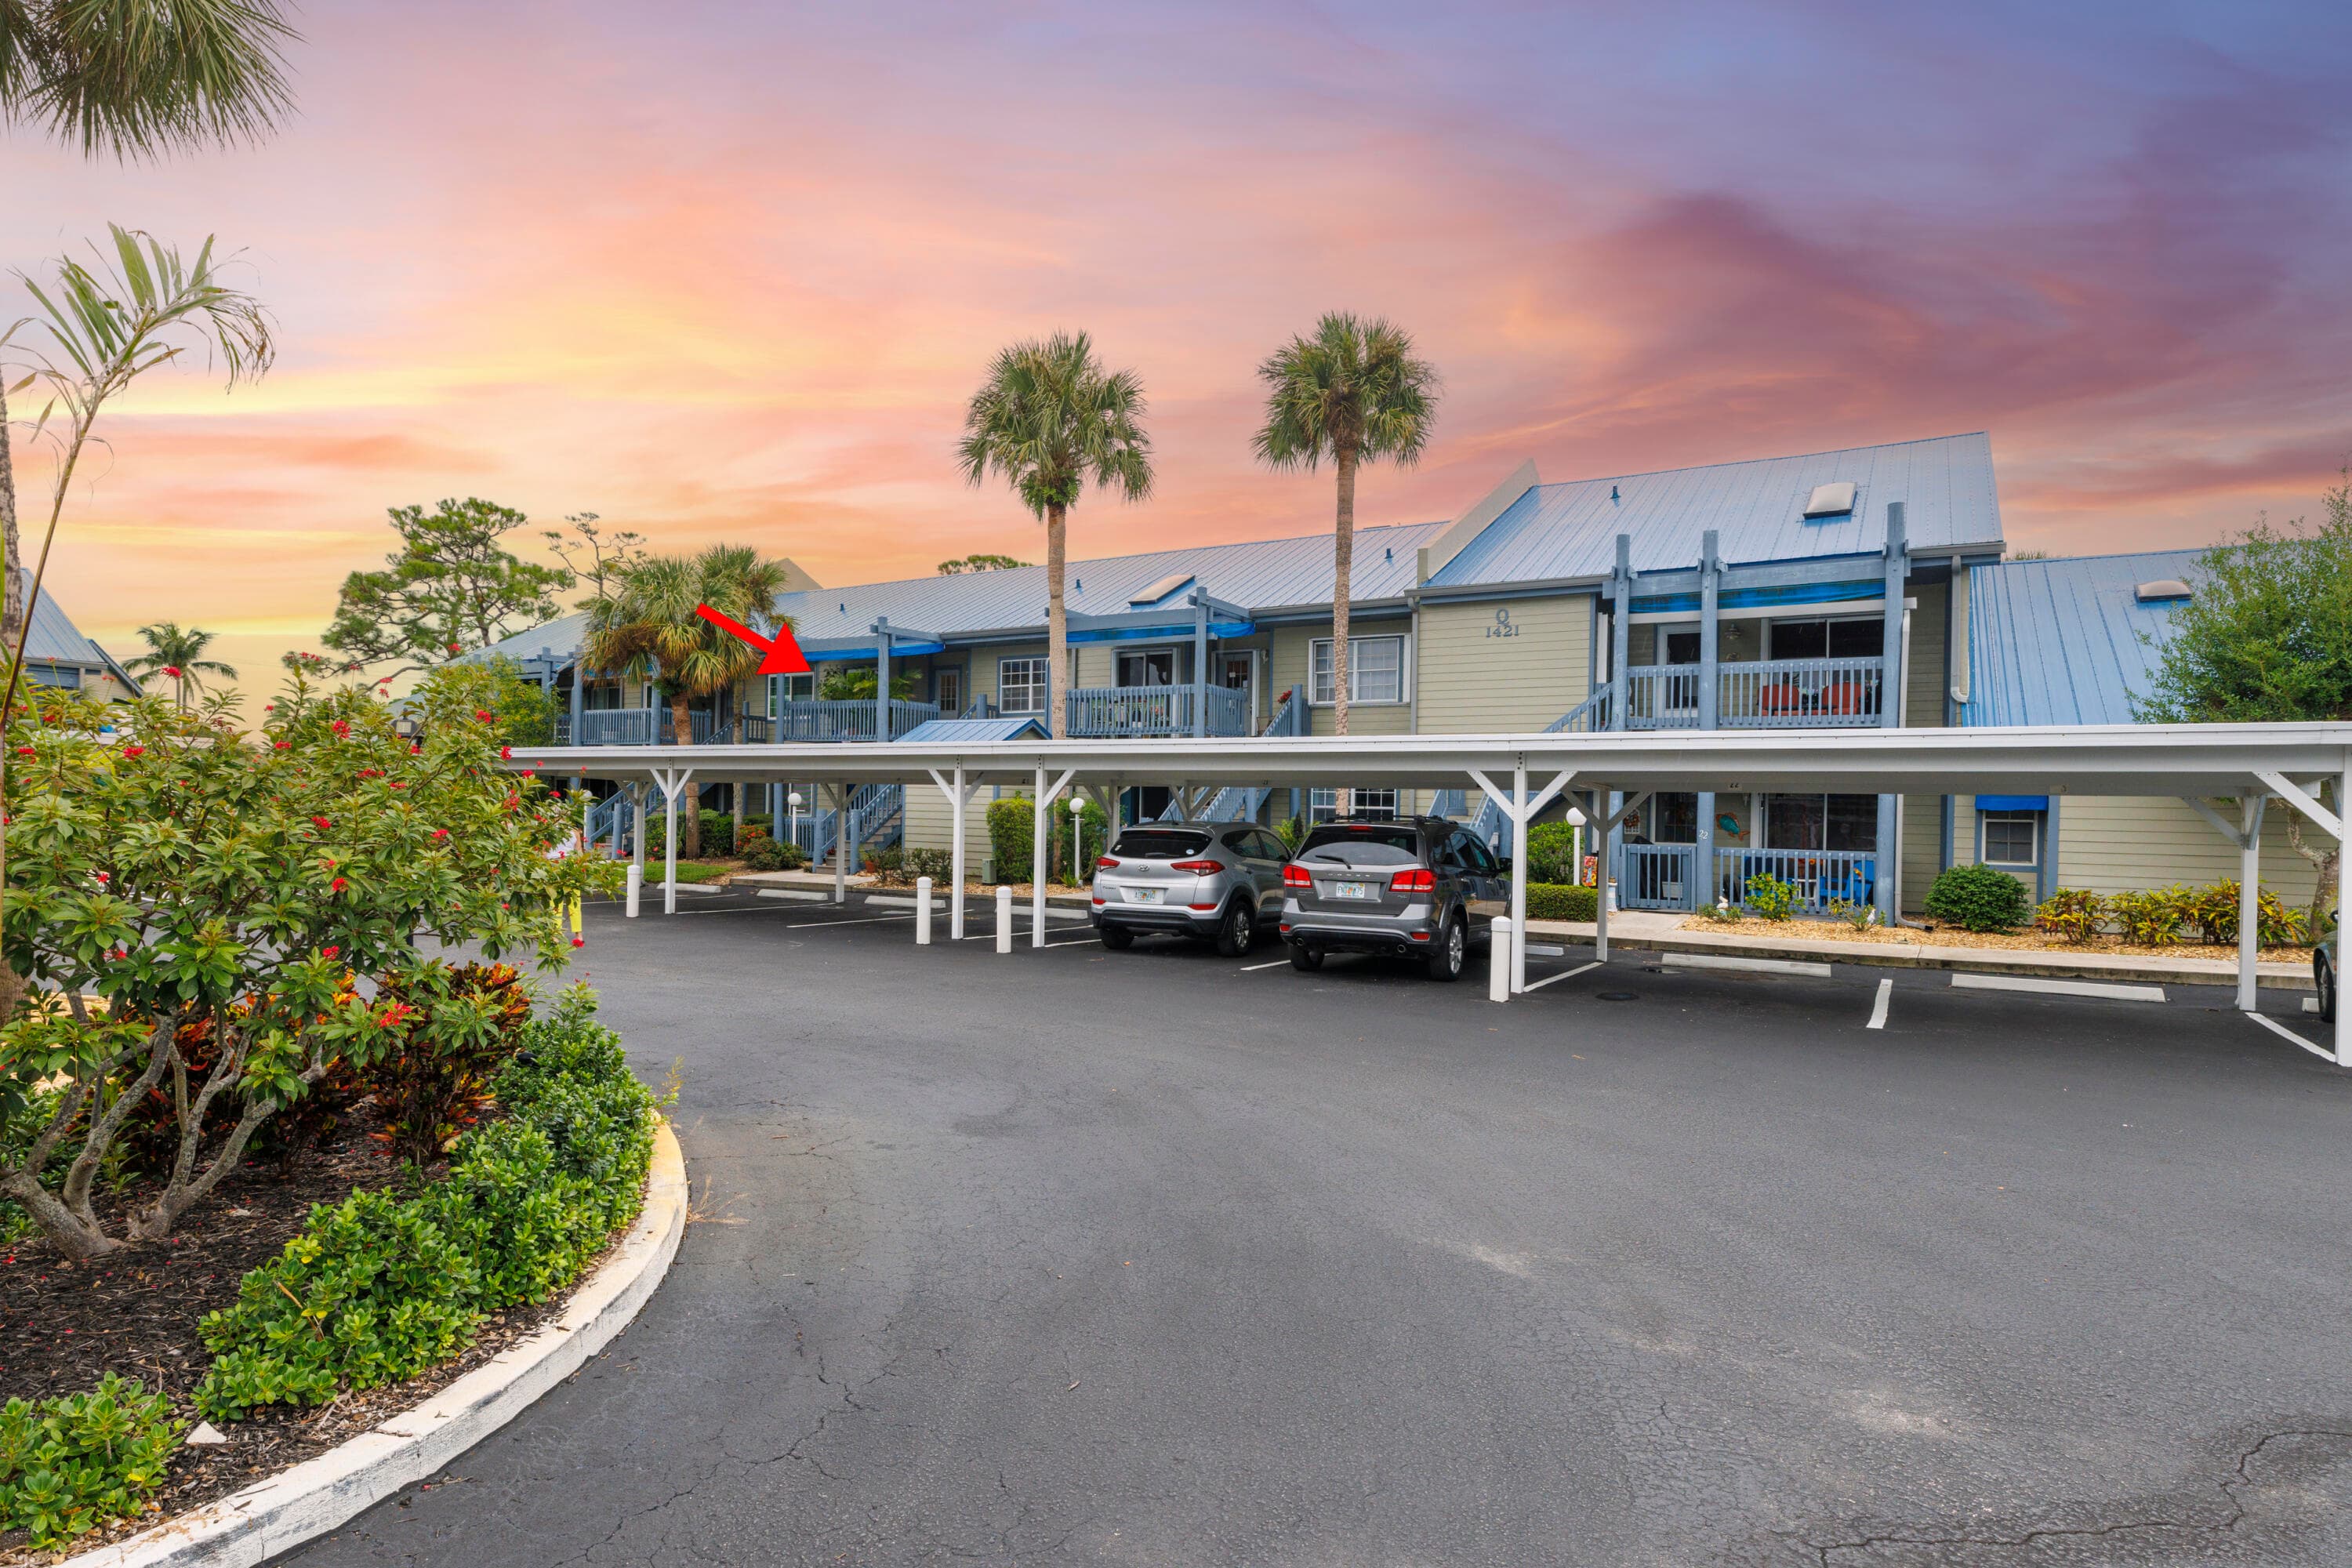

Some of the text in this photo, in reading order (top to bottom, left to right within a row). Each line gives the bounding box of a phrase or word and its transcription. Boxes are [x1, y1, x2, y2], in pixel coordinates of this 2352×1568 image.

[1496, 608, 1509, 626] Q
[1486, 625, 1519, 637] 1421
[1699, 829, 1708, 840] 22
